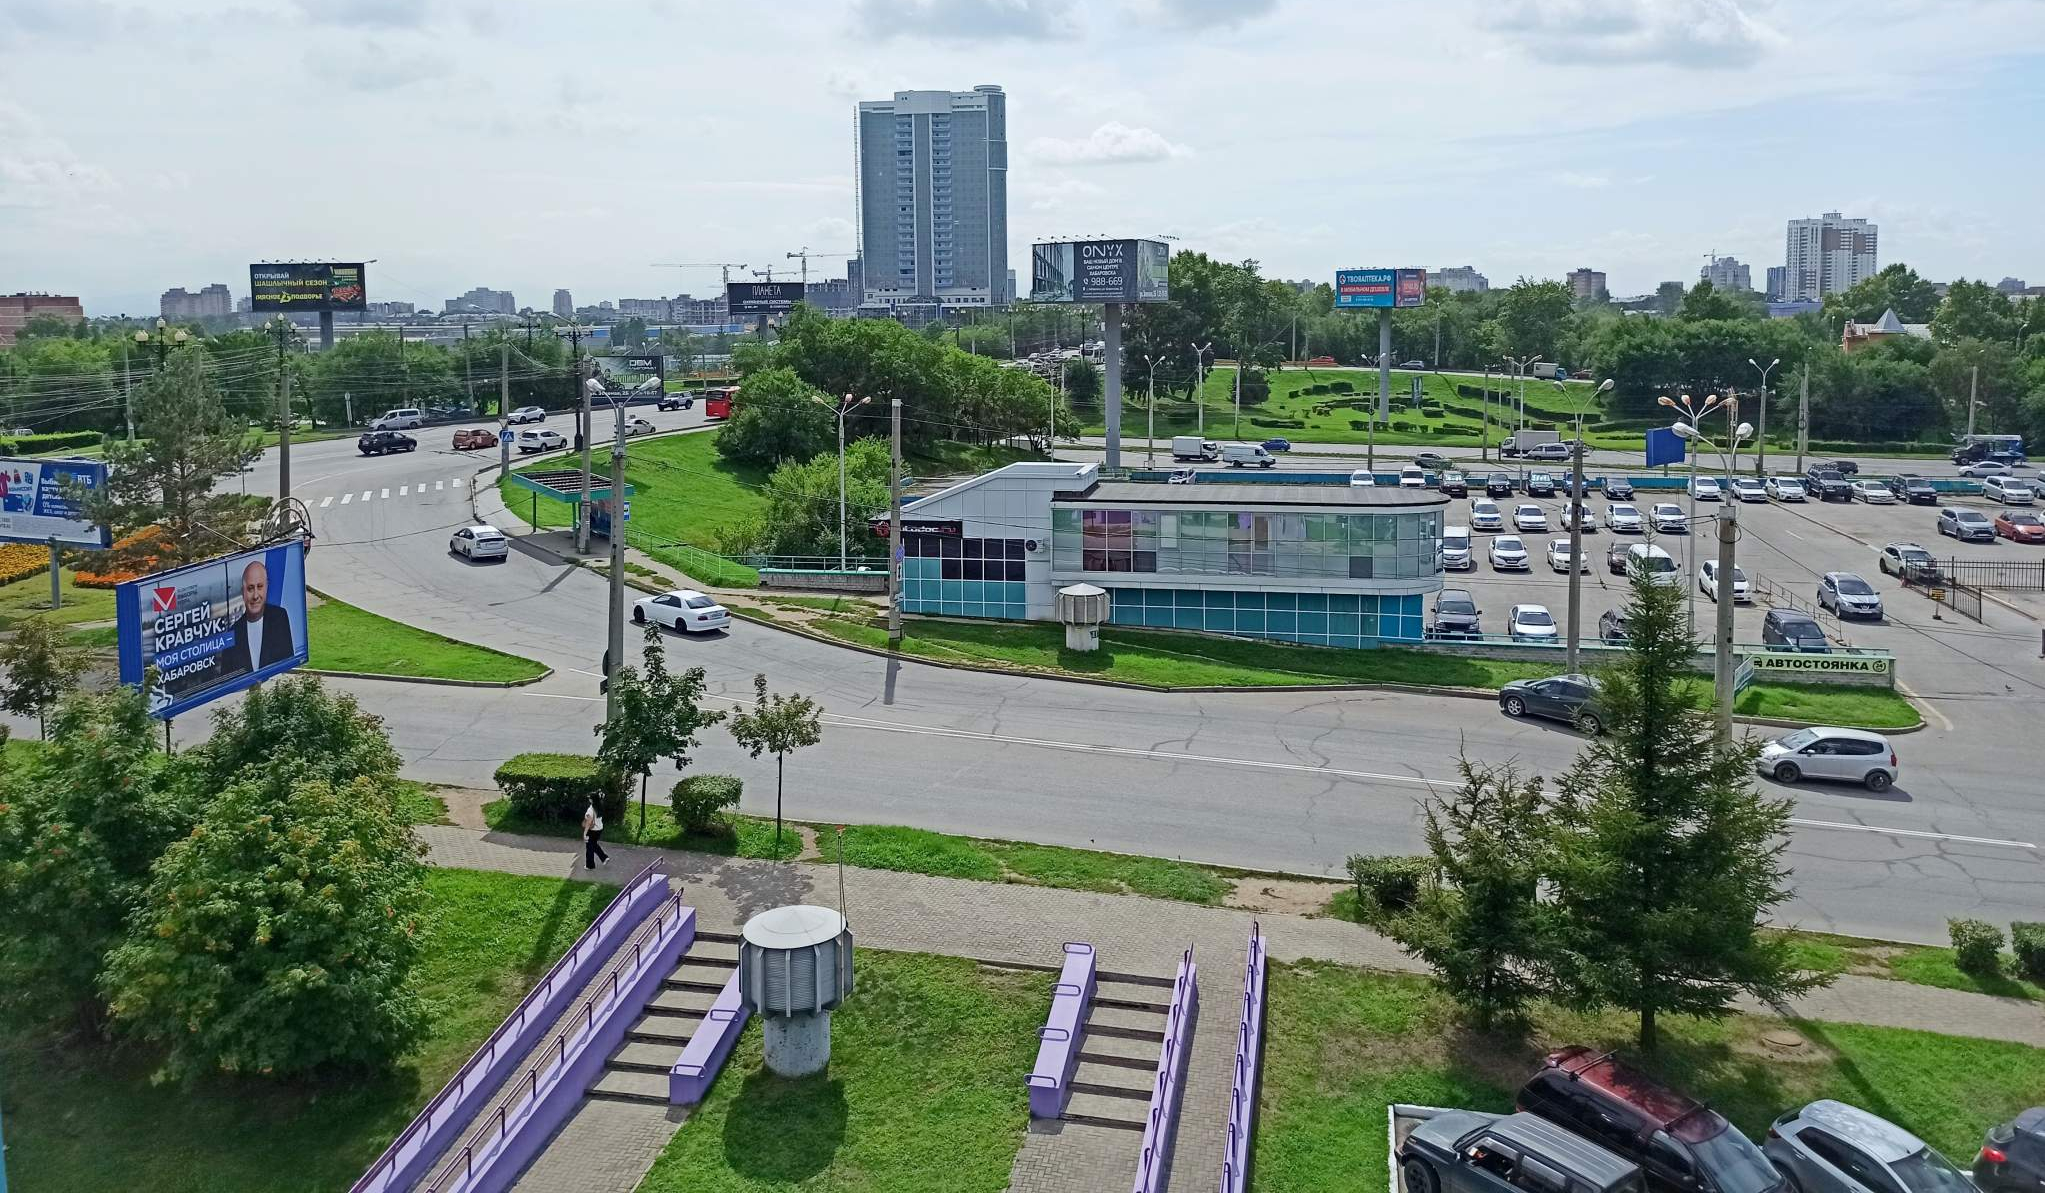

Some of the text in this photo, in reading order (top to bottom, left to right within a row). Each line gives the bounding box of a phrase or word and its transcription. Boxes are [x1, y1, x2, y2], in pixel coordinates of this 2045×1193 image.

[1082, 244, 1123, 257] ONYX
[254, 279, 328, 287] ШАШЛЫЧНЫЙ СЕЗОН
[1091, 277, 1123, 286] 988-669
[752, 285, 782, 296] ПЛАНЕТА
[154, 601, 210, 634] СЕРГЕЙ
[155, 618, 227, 653] КРАВЧУК:
[156, 651, 178, 668] МОЯ
[180, 638, 225, 660] СТОЛИЦА
[157, 656, 216, 685] ХАБАРОВСК
[1766, 659, 1869, 671] АВТОСТОЯНКА
